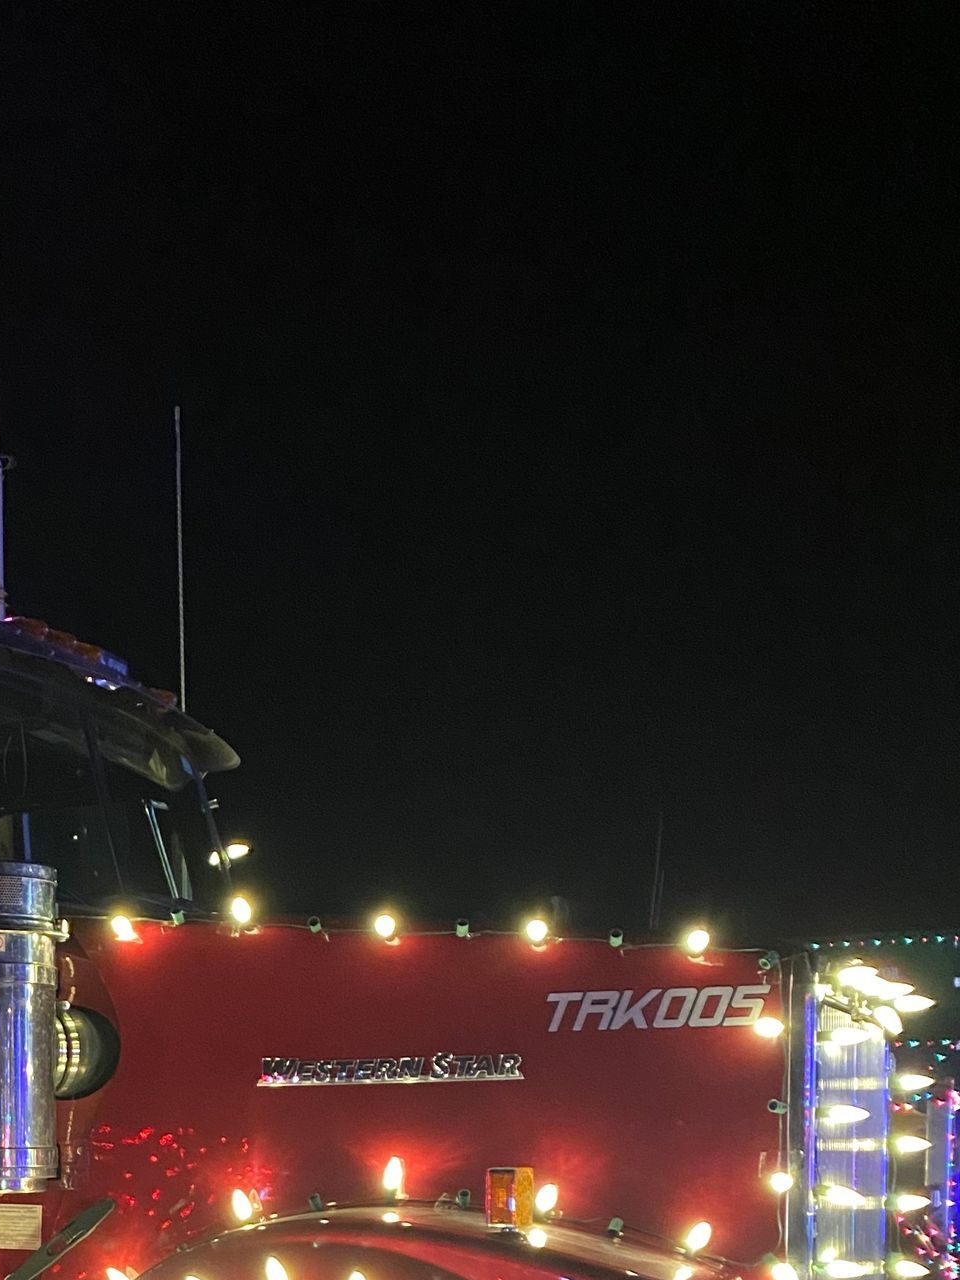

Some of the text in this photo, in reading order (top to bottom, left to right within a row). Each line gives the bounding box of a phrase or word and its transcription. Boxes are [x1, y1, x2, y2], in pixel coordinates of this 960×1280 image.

[546, 984, 772, 1033] TRK005
[261, 1051, 523, 1083] WESTERN STAR
